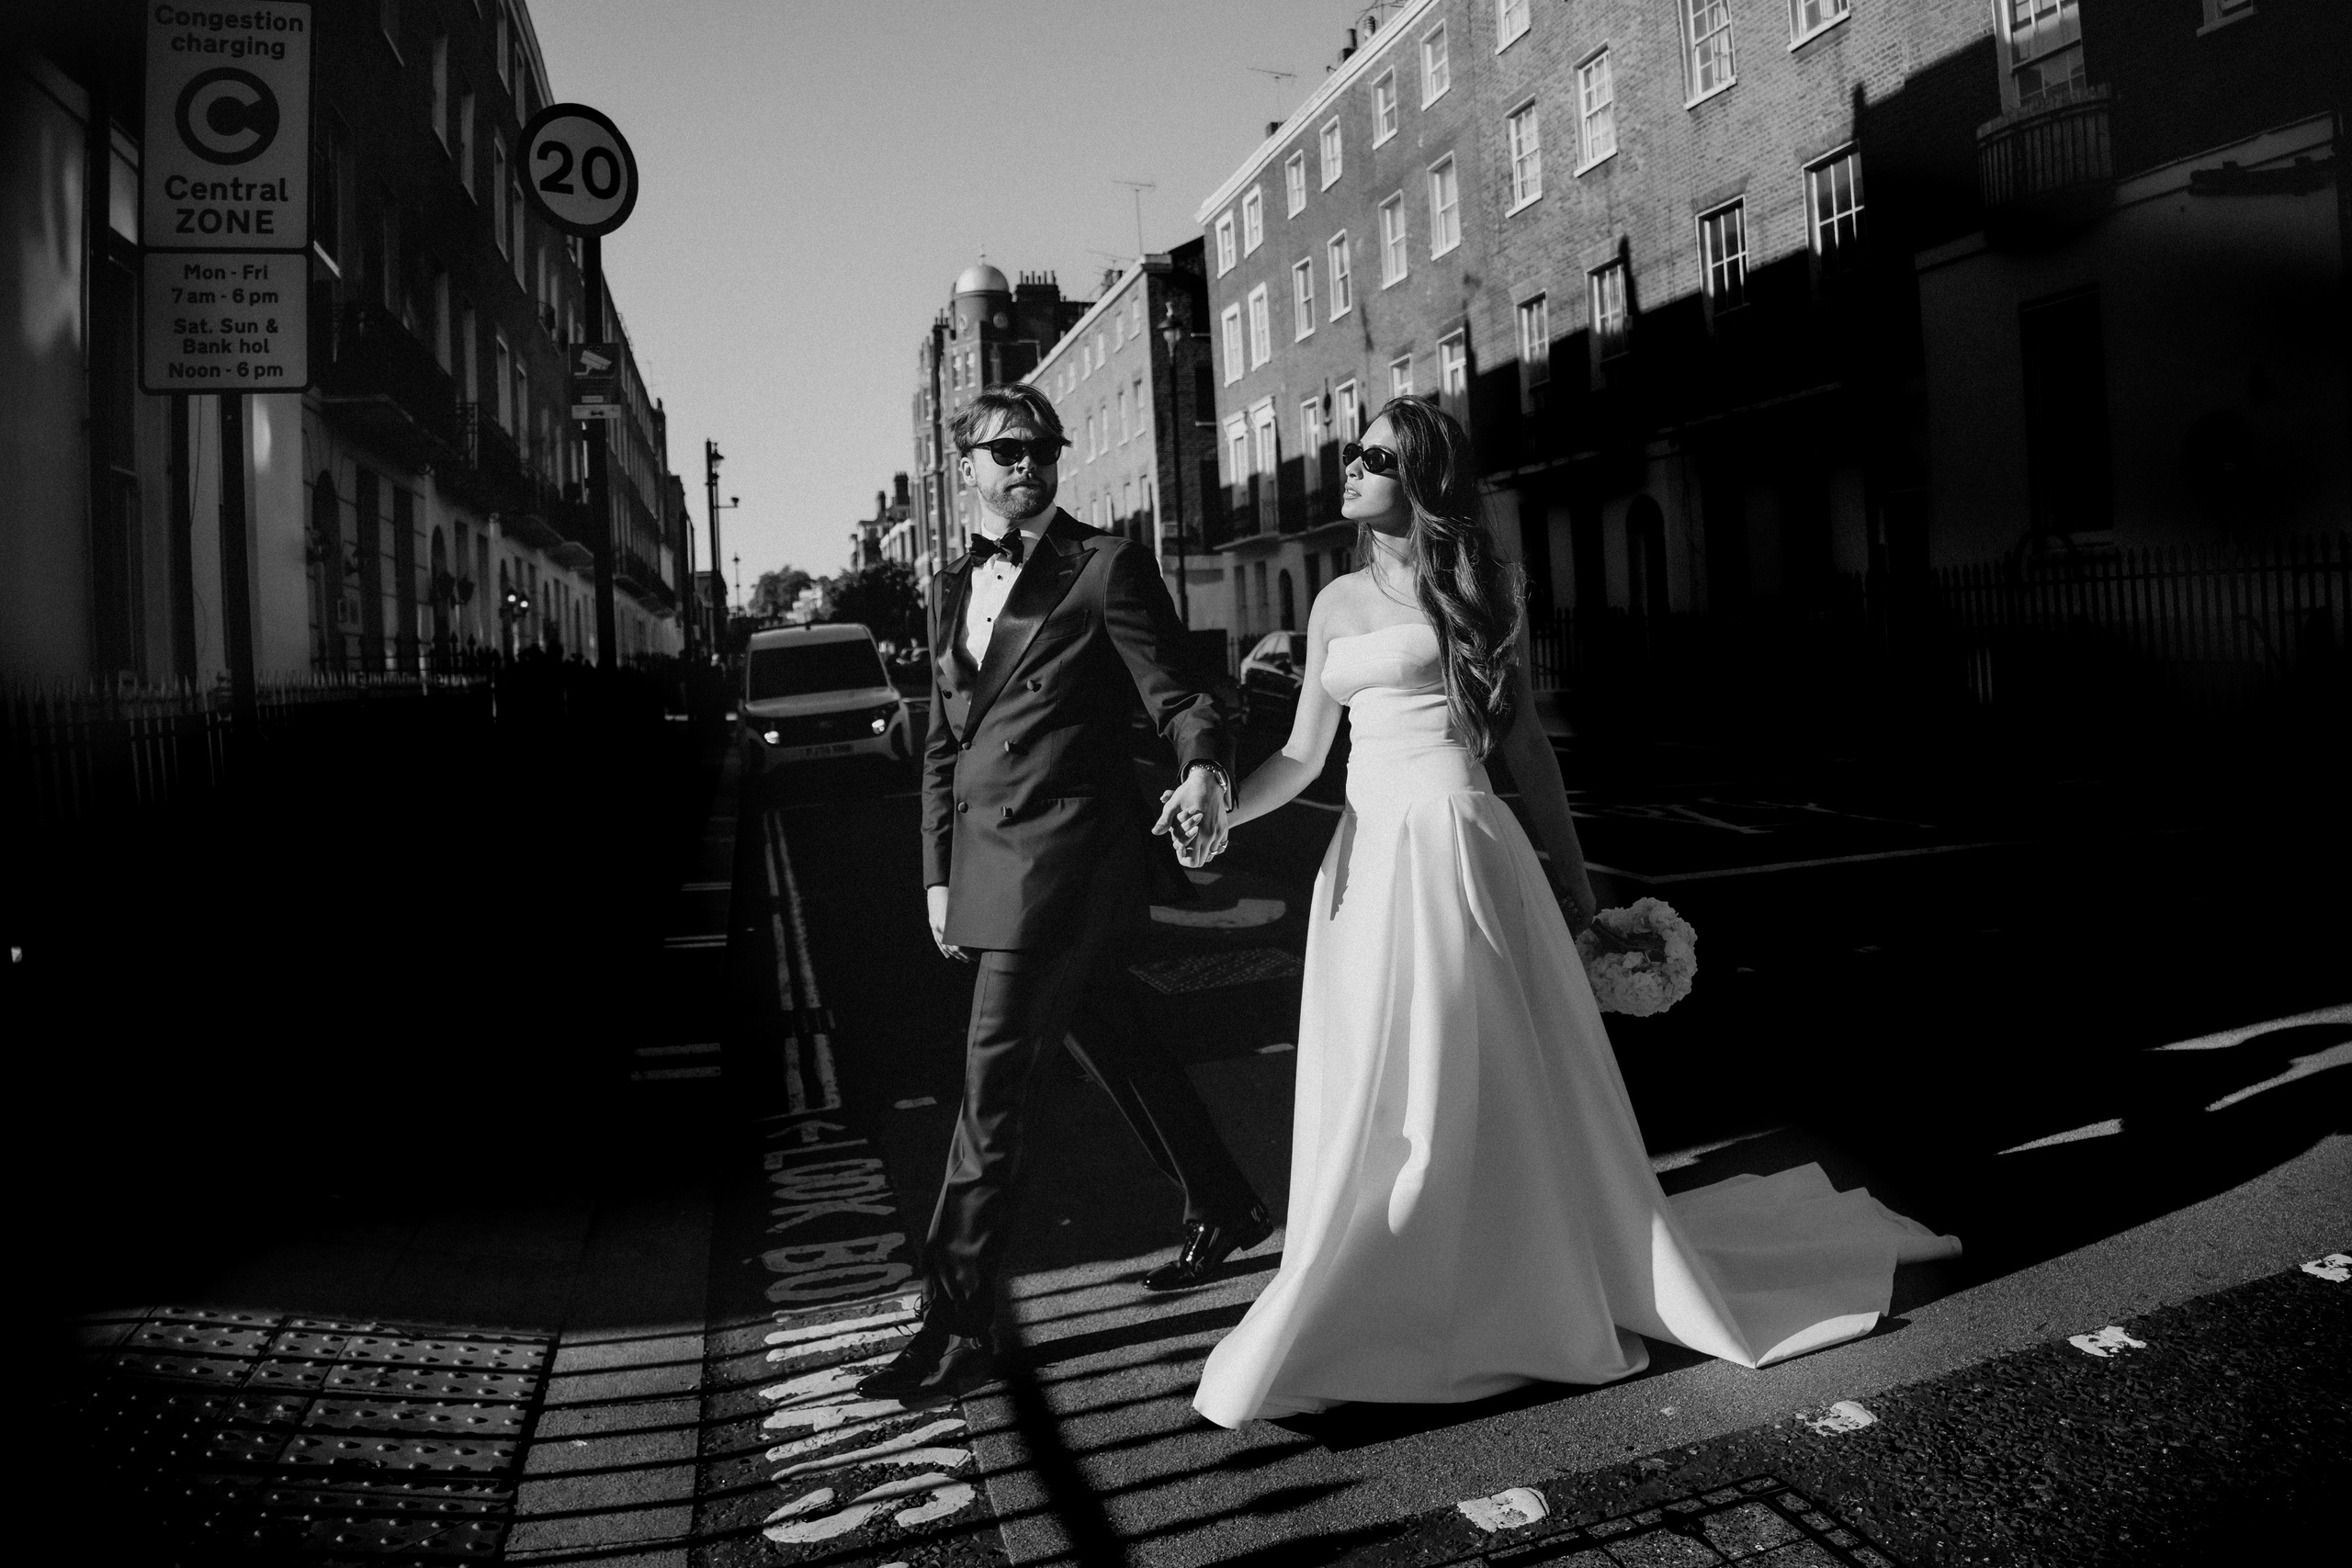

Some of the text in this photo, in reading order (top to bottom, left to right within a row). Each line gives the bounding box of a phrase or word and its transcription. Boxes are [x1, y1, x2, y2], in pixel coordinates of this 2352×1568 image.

[155, 4, 304, 32] Congestion
[170, 32, 286, 61] charging
[187, 79, 263, 153] C
[537, 140, 620, 200] 20
[164, 175, 288, 202] Central
[175, 209, 275, 234] ZONE
[184, 264, 226, 280] Mon
[243, 264, 268, 280] Fri
[220, 317, 259, 334] Sun
[266, 318, 278, 333] &
[182, 337, 270, 355] Bank hol
[168, 361, 221, 378] Noon
[763, 1138, 897, 1234] LOOK
[761, 1232, 924, 1360] BOTH
